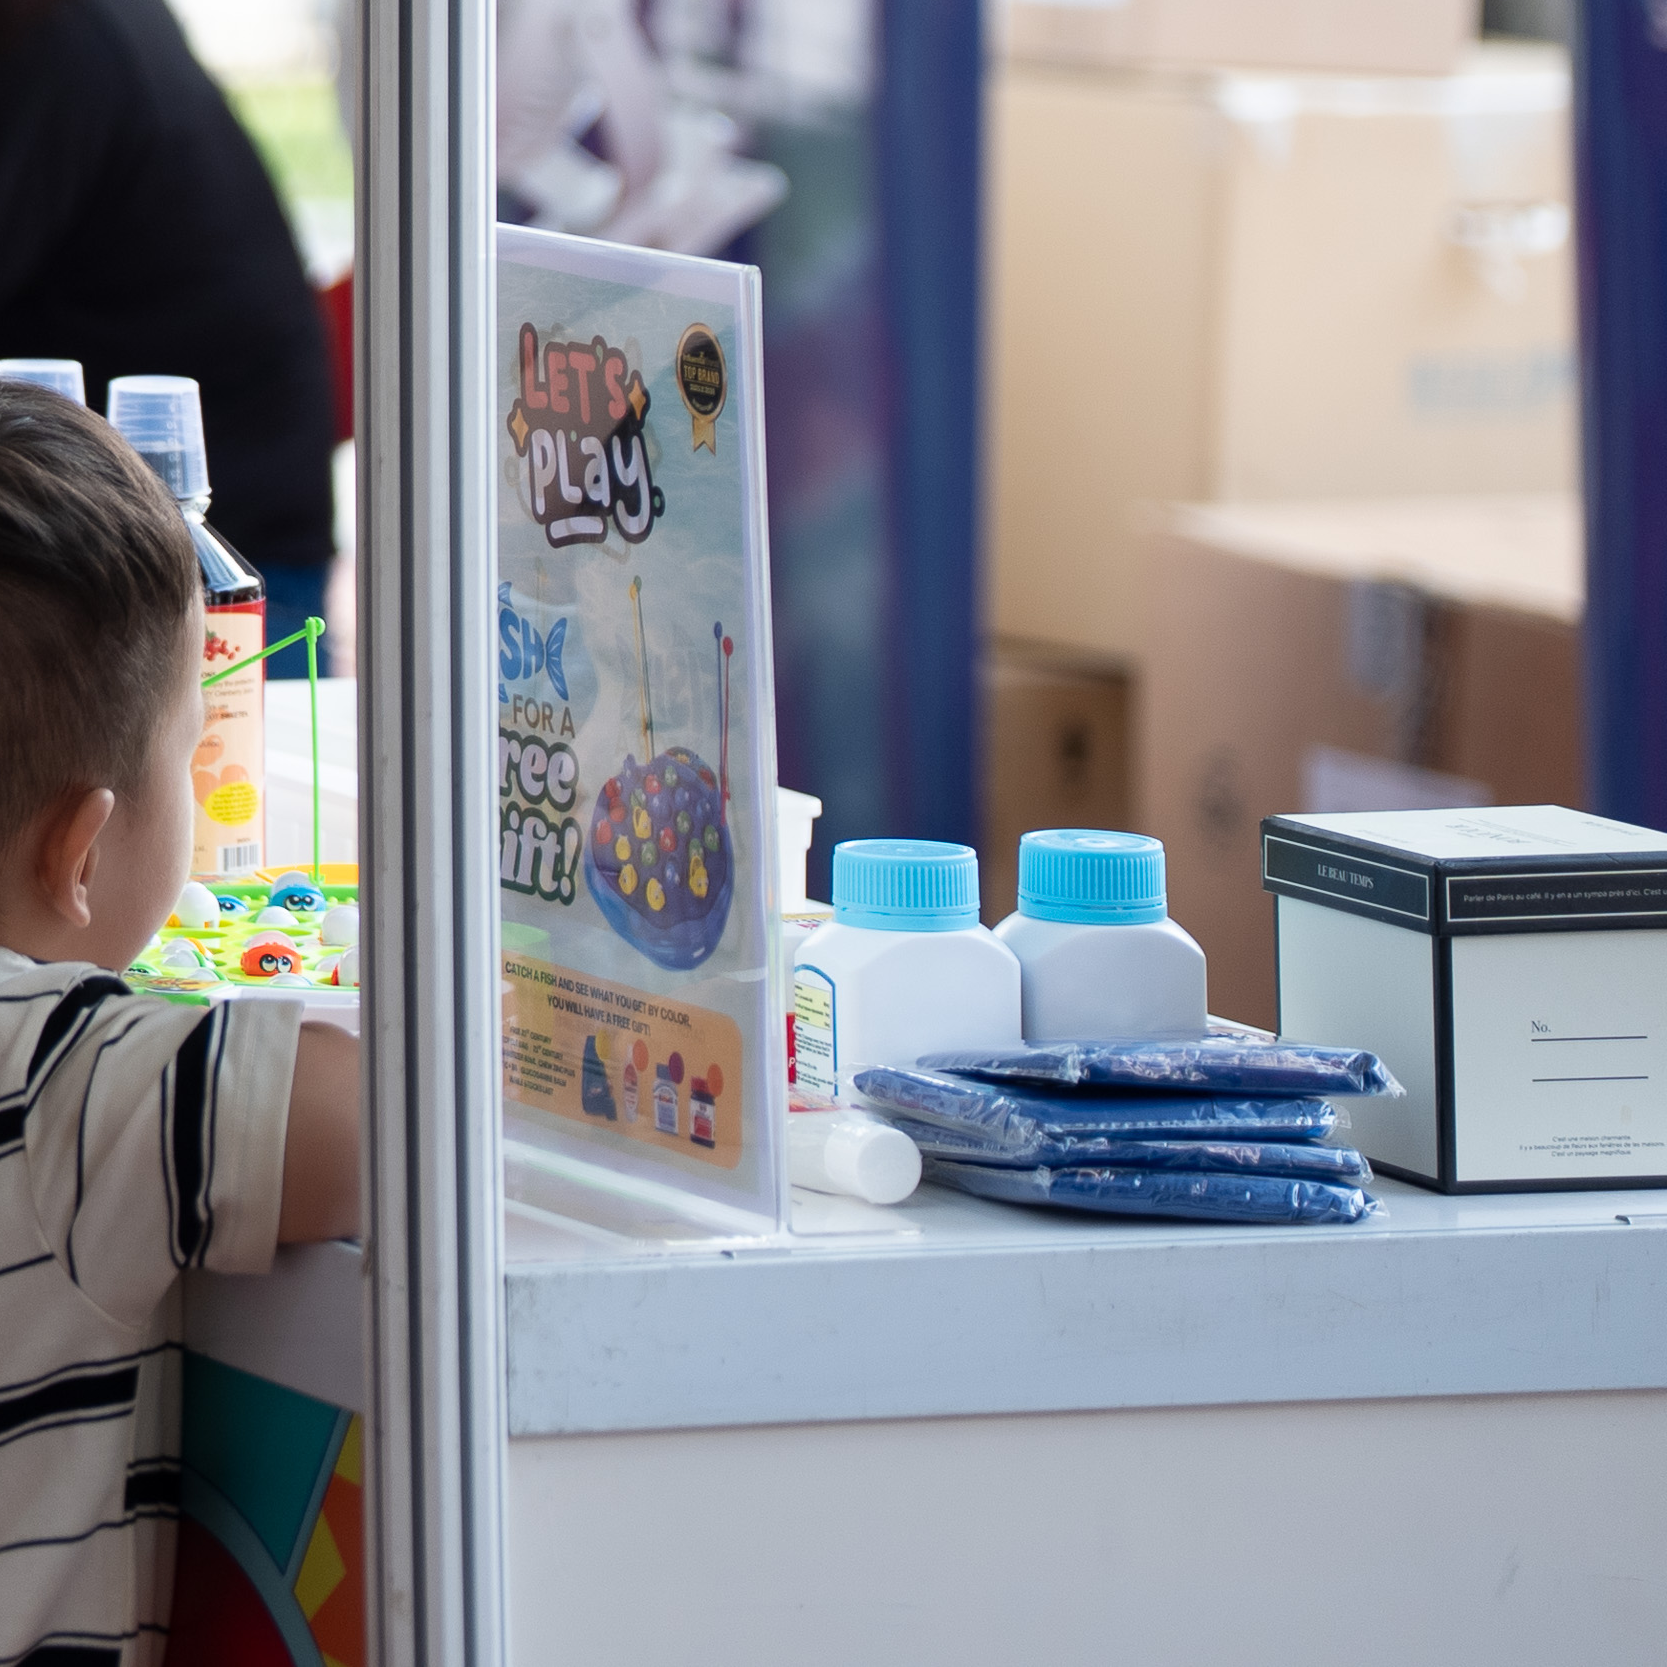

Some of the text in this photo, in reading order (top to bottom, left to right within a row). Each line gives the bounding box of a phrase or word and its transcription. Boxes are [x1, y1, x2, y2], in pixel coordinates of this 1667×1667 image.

[522, 326, 628, 425] LET'S
[683, 365, 696, 380] TOP
[499, 607, 545, 681] SH
[512, 693, 576, 739] FOR A
[499, 730, 578, 808] ree
[499, 803, 581, 904] ift!
[1317, 864, 1375, 889] LE BEAU TEMPS
[1463, 894, 1484, 902] Parler
[505, 960, 532, 979] CATCH
[533, 969, 539, 981] A
[540, 972, 556, 985] FISH
[558, 977, 573, 991] AND
[575, 982, 588, 995] SEE
[589, 986, 613, 1003] WHAT
[615, 994, 632, 1009] YOU
[632, 999, 645, 1013] GET
[648, 1004, 658, 1016] BY
[547, 994, 563, 1009] YOU
[565, 1000, 583, 1015] WILL
[584, 1005, 605, 1021] HAVE
[606, 1012, 612, 1023] A
[612, 1014, 630, 1029] FREE
[1530, 1020, 1551, 1033] No.
